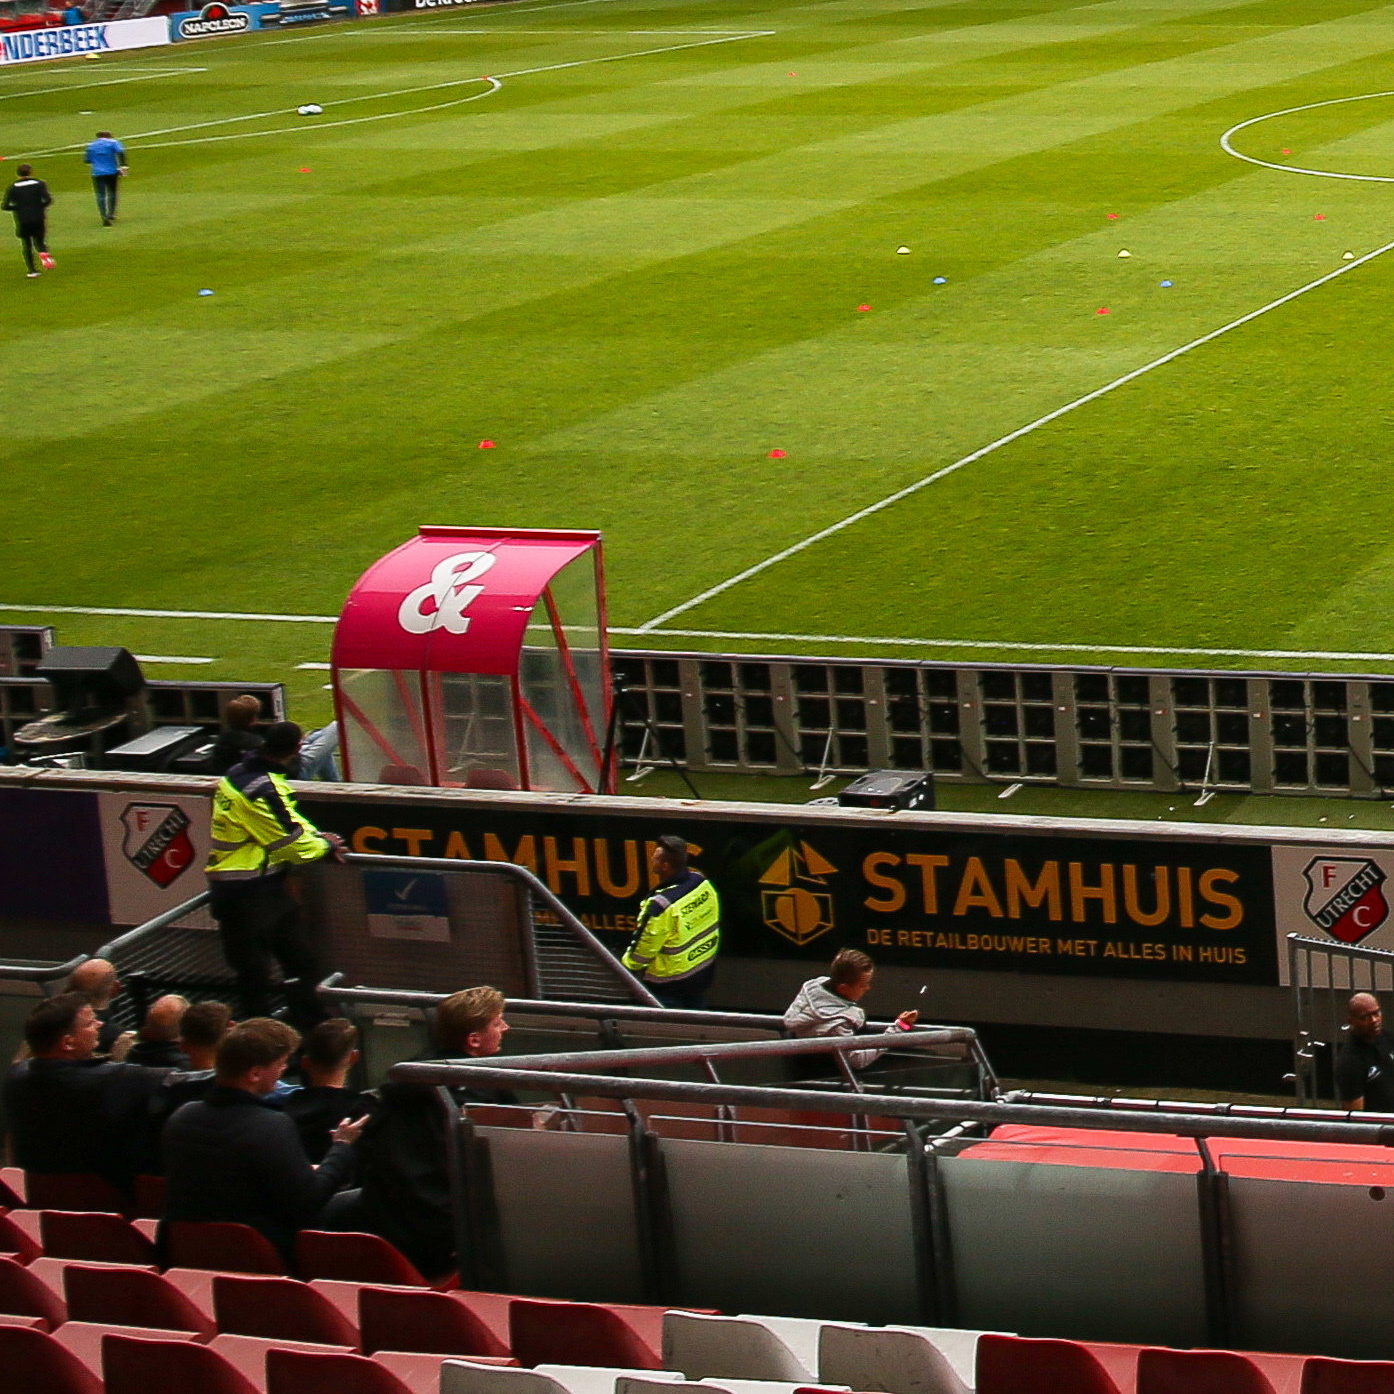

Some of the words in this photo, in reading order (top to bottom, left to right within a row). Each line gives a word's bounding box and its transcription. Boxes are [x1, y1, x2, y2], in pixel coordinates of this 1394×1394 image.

[0, 25, 110, 61] NDERBEEK
[862, 851, 1243, 930] STAMHUIS
[1316, 866, 1379, 928] UTRECHT
[867, 928, 892, 946] DE
[898, 931, 1051, 955] RETAILBOUWER
[1057, 939, 1098, 957] MET
[1104, 942, 1165, 960] ALLES
[1173, 945, 1193, 962] IN
[1200, 947, 1246, 964] HUIS
